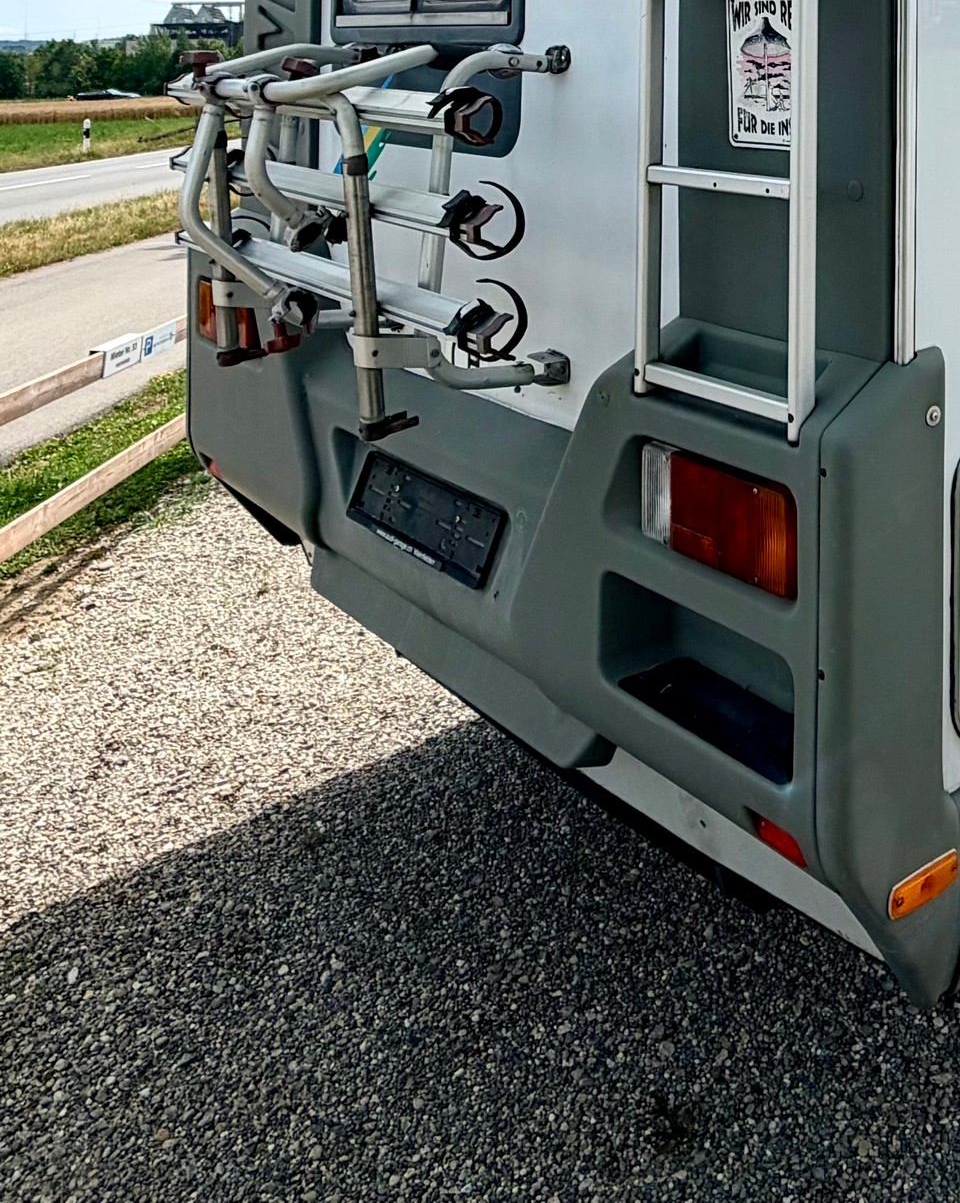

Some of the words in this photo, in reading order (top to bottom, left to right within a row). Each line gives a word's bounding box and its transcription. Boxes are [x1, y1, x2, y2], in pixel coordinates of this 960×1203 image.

[754, 0, 776, 16] SIND
[760, 119, 775, 135] DIE
[778, 117, 791, 136] IN
